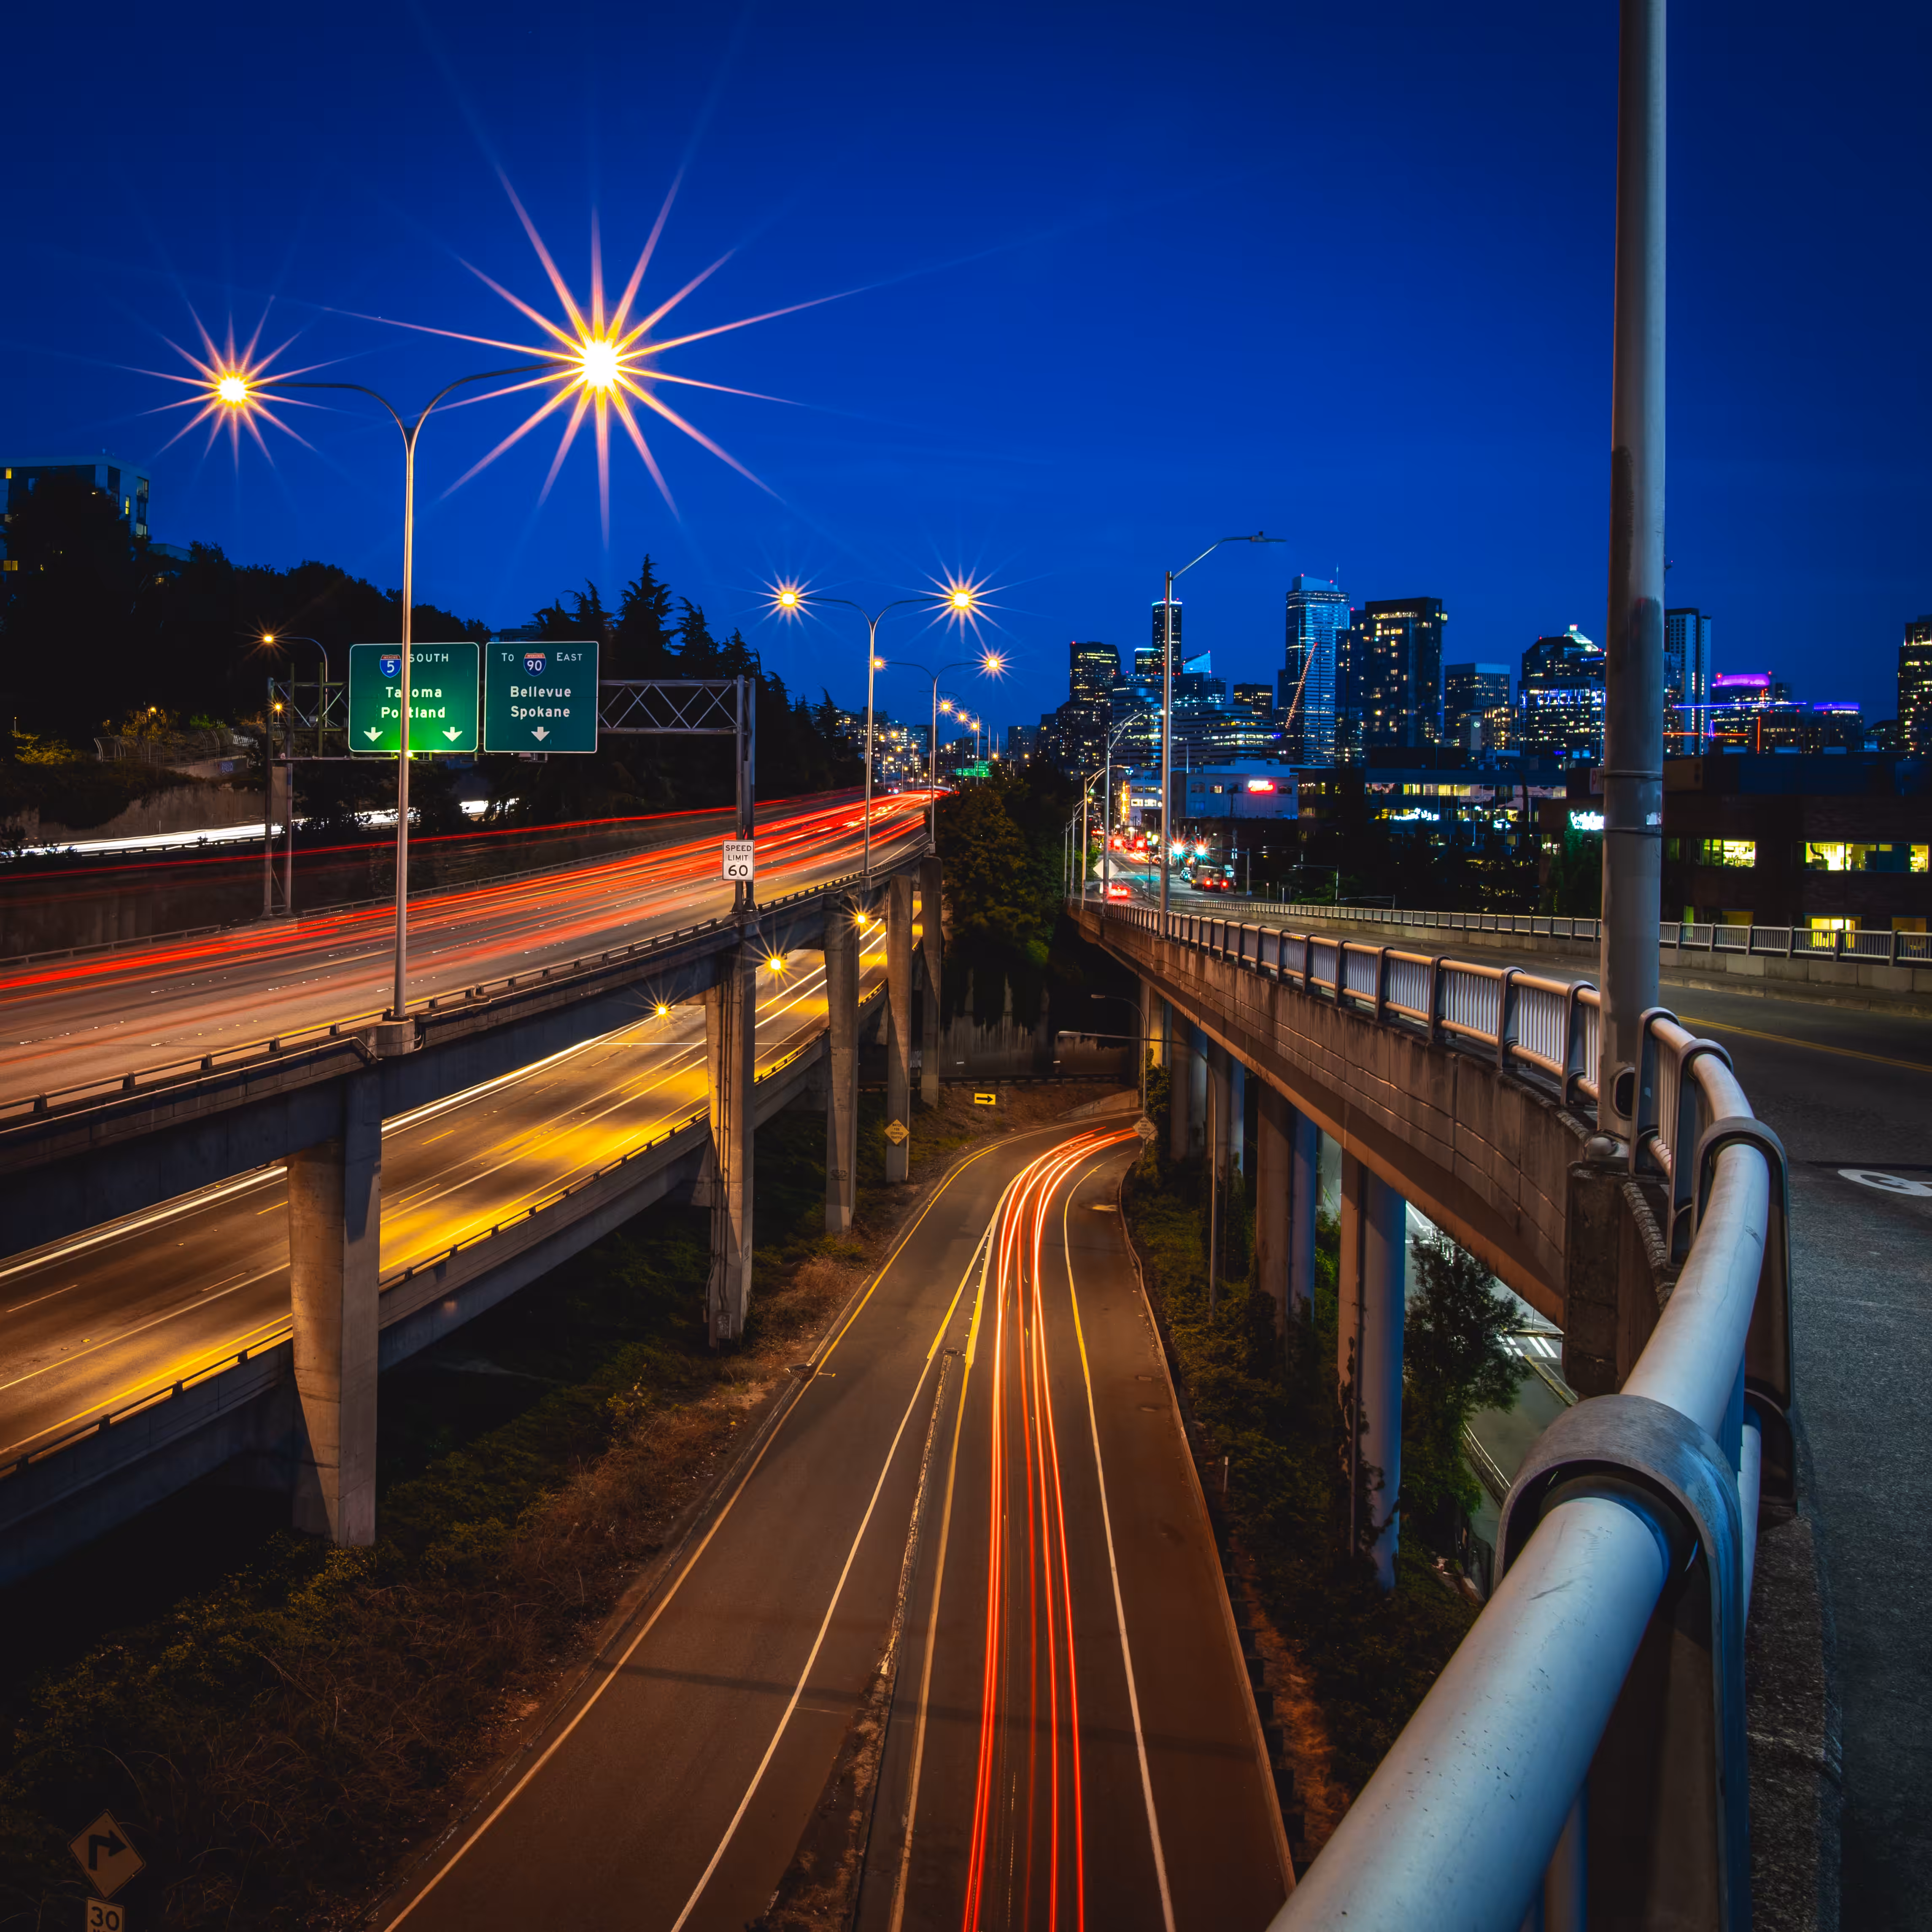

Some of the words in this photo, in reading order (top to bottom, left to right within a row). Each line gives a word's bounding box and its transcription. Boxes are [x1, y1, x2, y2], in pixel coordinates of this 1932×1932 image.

[409, 653, 449, 663] SOUTH
[556, 652, 583, 661] EAST
[386, 660, 395, 673] 5
[527, 660, 542, 671] 90
[385, 686, 442, 698] Taoma
[510, 685, 572, 697] Bellevue
[381, 706, 445, 718] Potland
[510, 705, 570, 720] Spokane
[728, 864, 748, 877] 60
[90, 1906, 120, 1932] 30
